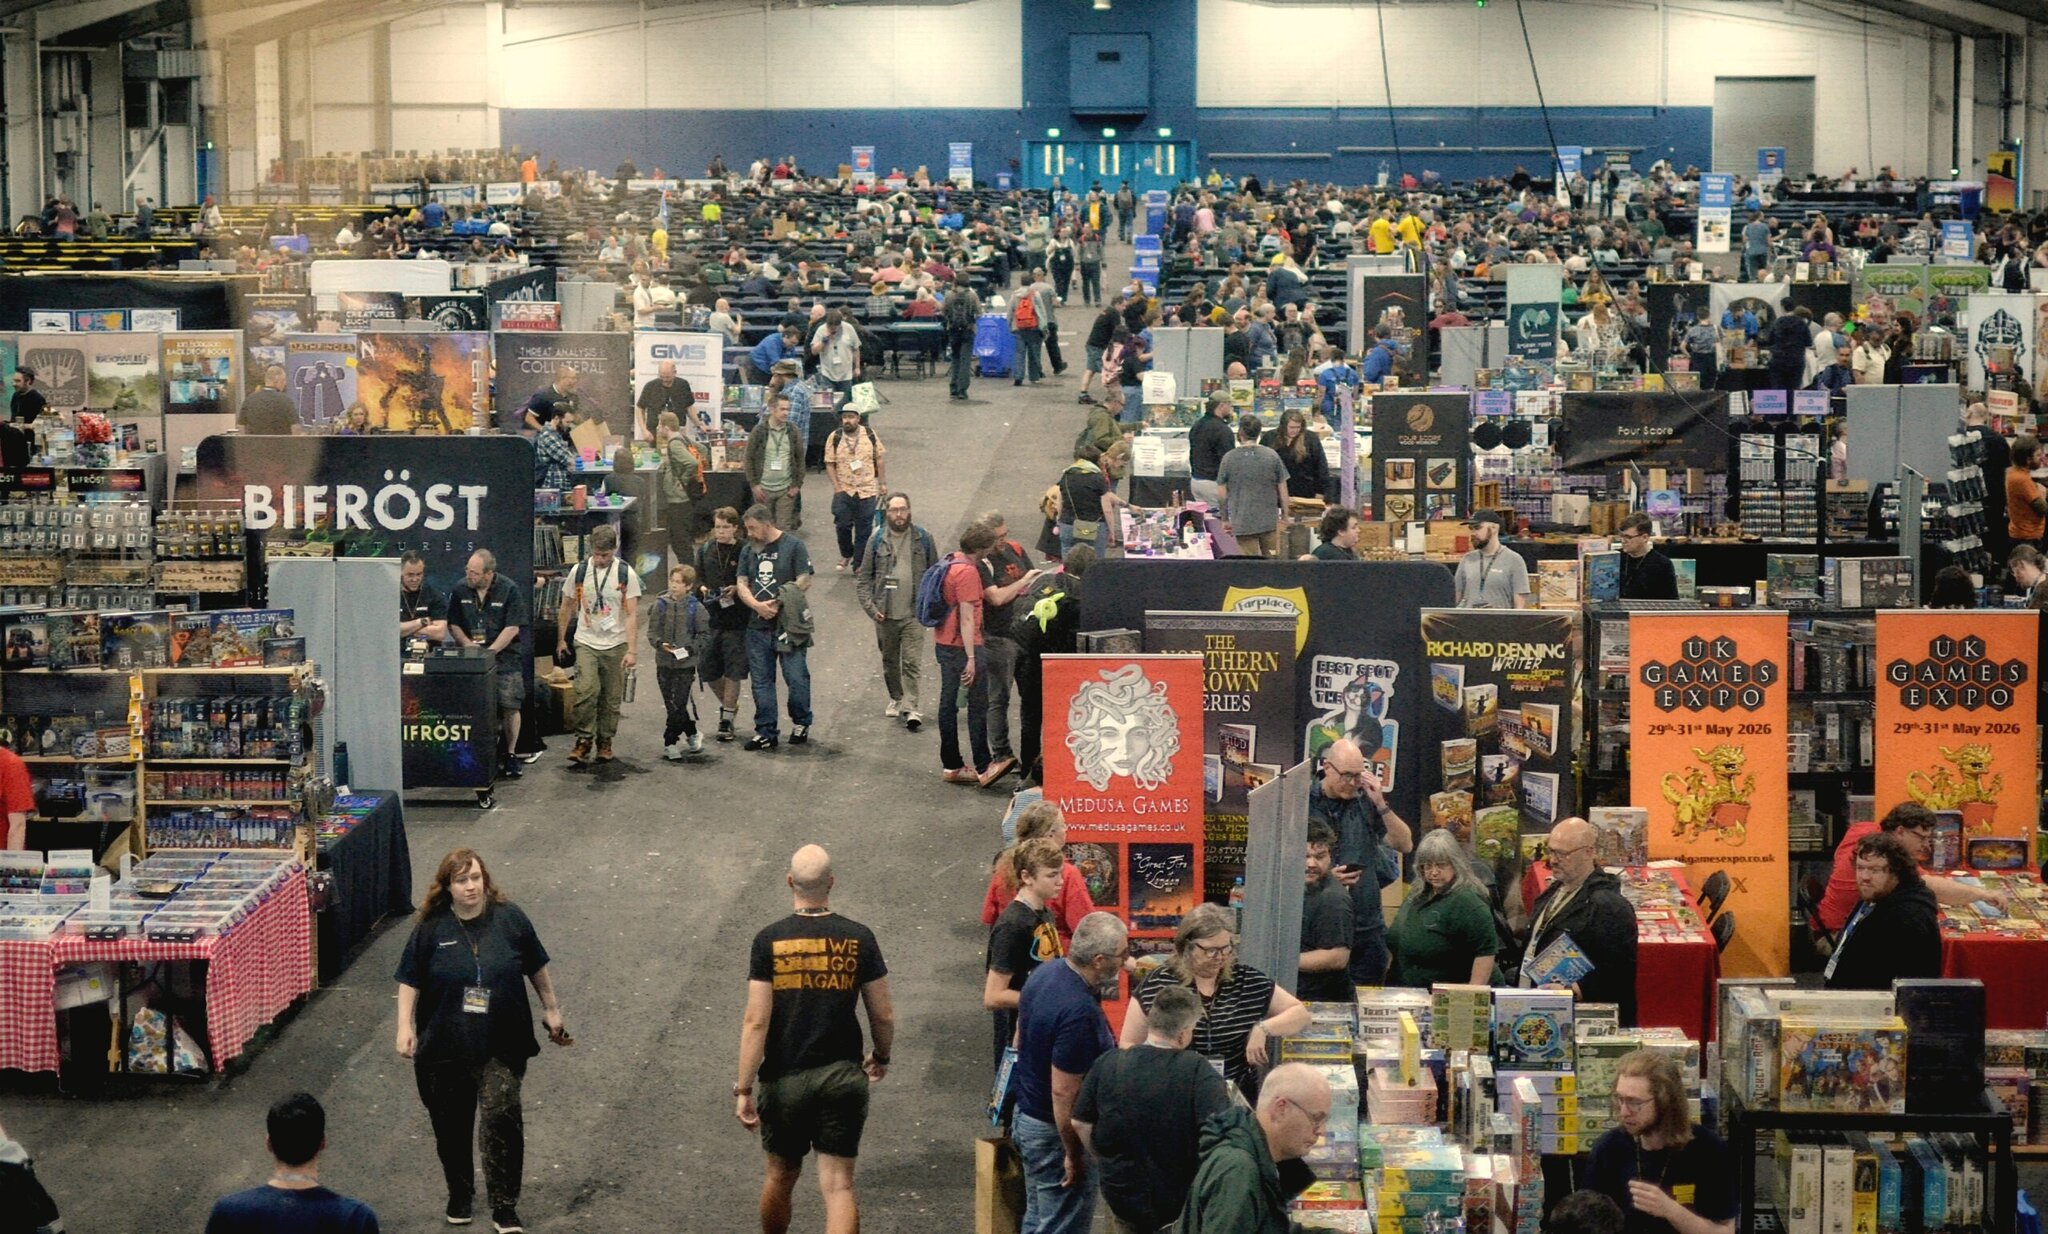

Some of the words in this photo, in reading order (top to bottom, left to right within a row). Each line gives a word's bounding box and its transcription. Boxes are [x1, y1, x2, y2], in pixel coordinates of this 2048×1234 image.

[502, 304, 555, 313] MASS
[520, 347, 553, 357] THREAT
[555, 347, 597, 357] ANALYSIS
[650, 344, 706, 359] GMS
[520, 361, 604, 373] COLLERAL
[47, 395, 76, 405] AMES
[1618, 426, 1641, 435] Four
[1643, 426, 1673, 435] Score
[244, 469, 488, 531] BIFRÖST
[221, 614, 253, 624] BLOOD
[254, 612, 281, 622] BOWL
[1205, 635, 1236, 650] THE
[1426, 641, 1494, 657] RICHARD
[1497, 642, 1566, 659] DENNING
[1688, 641, 1731, 658] UK
[1936, 641, 1981, 658] UK
[1317, 660, 1354, 676] BEST
[1356, 663, 1395, 679] SPOT
[1491, 657, 1543, 672] WRITER
[1645, 665, 1770, 683] GAMES
[1892, 665, 2020, 682] GAMES
[1315, 675, 1332, 688] IN
[1203, 694, 1251, 712] ERIES
[1315, 690, 1344, 705] THE
[1663, 689, 1760, 707] EXPO
[1909, 688, 2008, 705] EXPO
[403, 720, 472, 741] IFRÖST
[1706, 724, 1733, 737] May
[1737, 724, 1772, 735] 2026
[1953, 723, 1982, 736] May
[1985, 723, 2021, 734] 2026
[1059, 797, 1126, 814] MEDUSA
[1133, 796, 1190, 815] GAMES
[1064, 822, 1186, 833] www.medusagames.co.uk
[1204, 856, 1232, 864] BOUT
[1648, 854, 1775, 865] ukgamesexpo.co.uk
[829, 938, 859, 955] WE
[831, 956, 857, 972] GO
[802, 973, 855, 990] AGAIN
